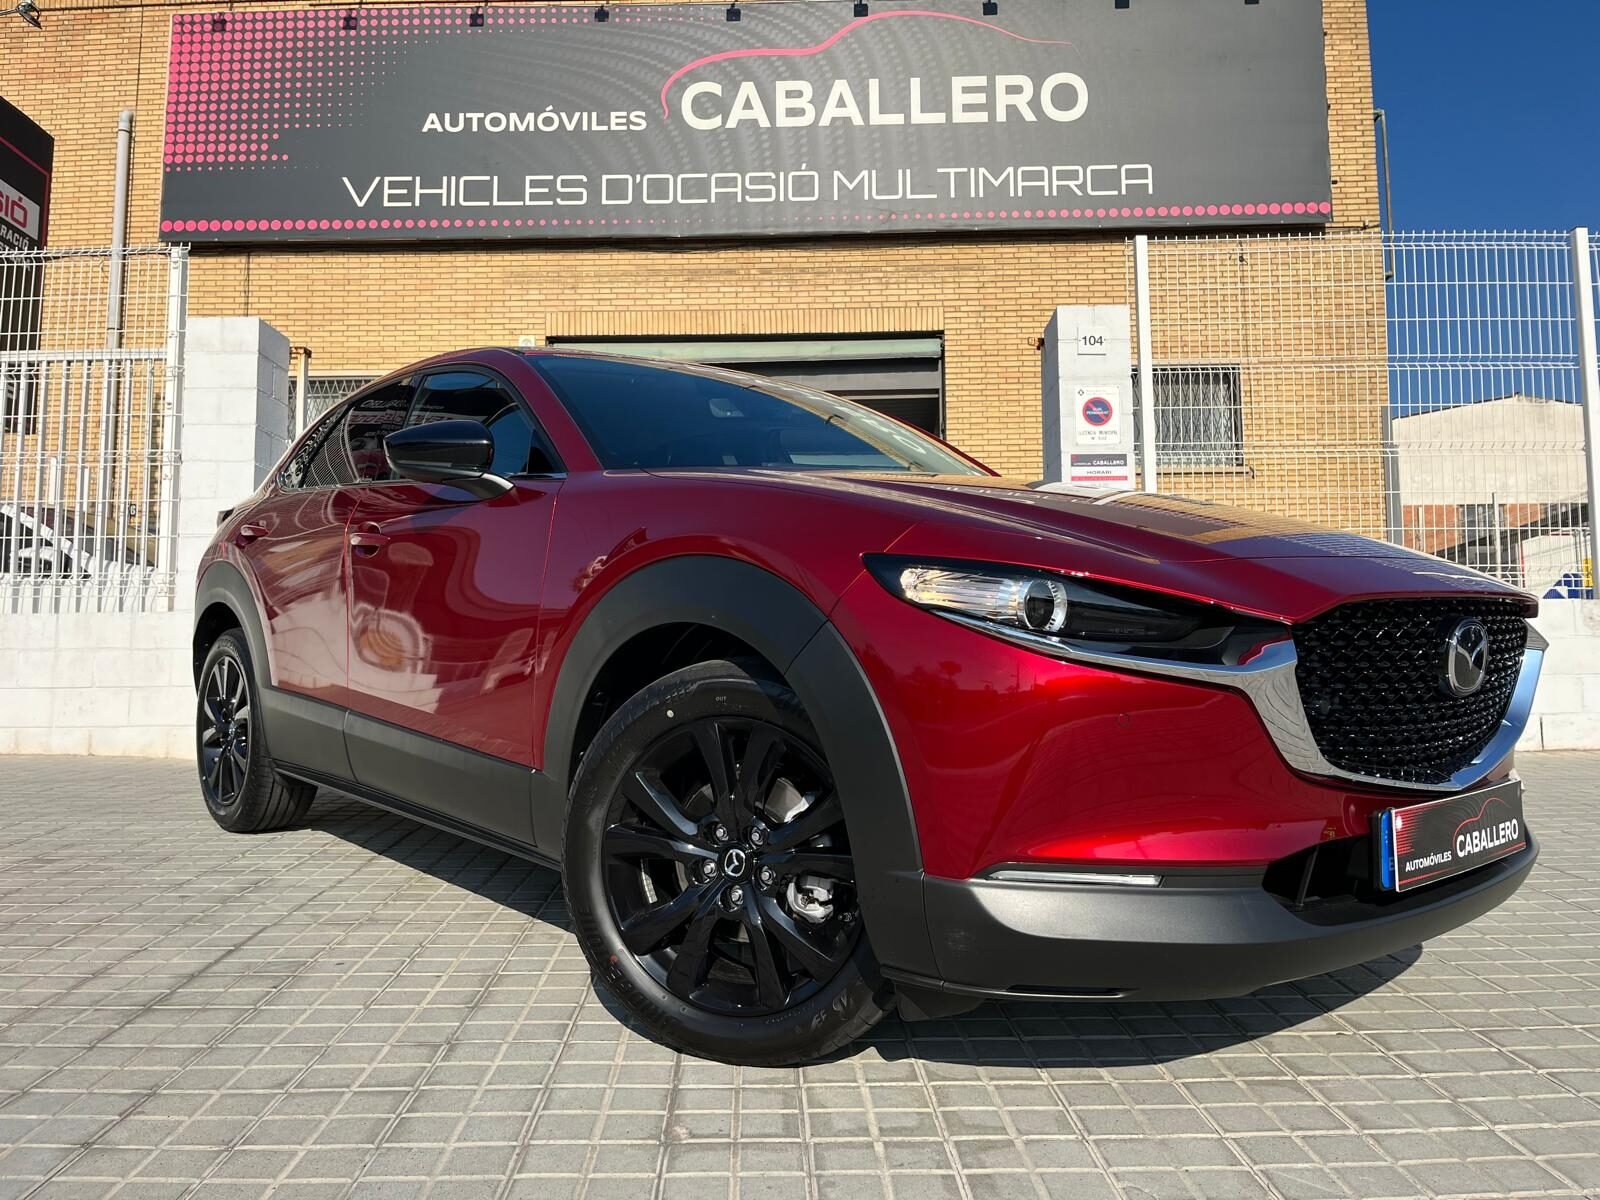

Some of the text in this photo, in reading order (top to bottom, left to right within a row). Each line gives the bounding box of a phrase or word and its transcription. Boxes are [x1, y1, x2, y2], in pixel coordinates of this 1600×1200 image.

[421, 71, 1090, 133] AUTOMÓVILES CABALLERO
[341, 174, 588, 207] VEHICLES
[600, 162, 820, 205] D'OCASIÓ
[1081, 335, 1105, 347] 104
[1405, 818, 1519, 872] AUTOMÓVILES CABALLERO
